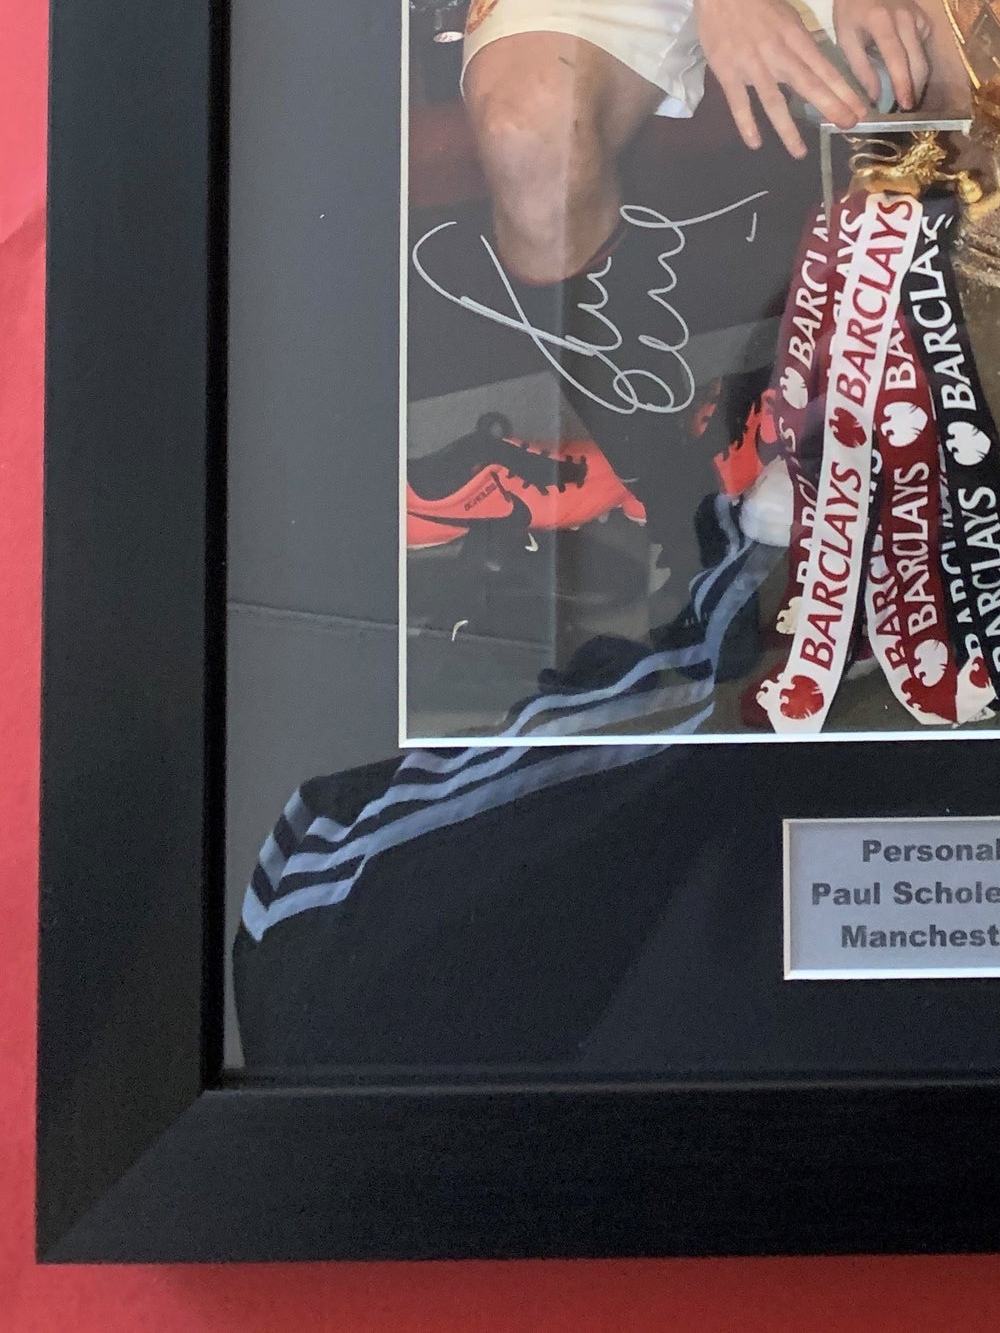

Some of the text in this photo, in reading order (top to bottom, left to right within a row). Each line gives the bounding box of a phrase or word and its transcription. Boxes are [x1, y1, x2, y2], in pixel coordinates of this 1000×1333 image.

[836, 200, 913, 408] BARCLAYS
[800, 461, 862, 671] BARCLAYS
[892, 461, 938, 636] BARCLAYS
[811, 881, 881, 906] Paul
